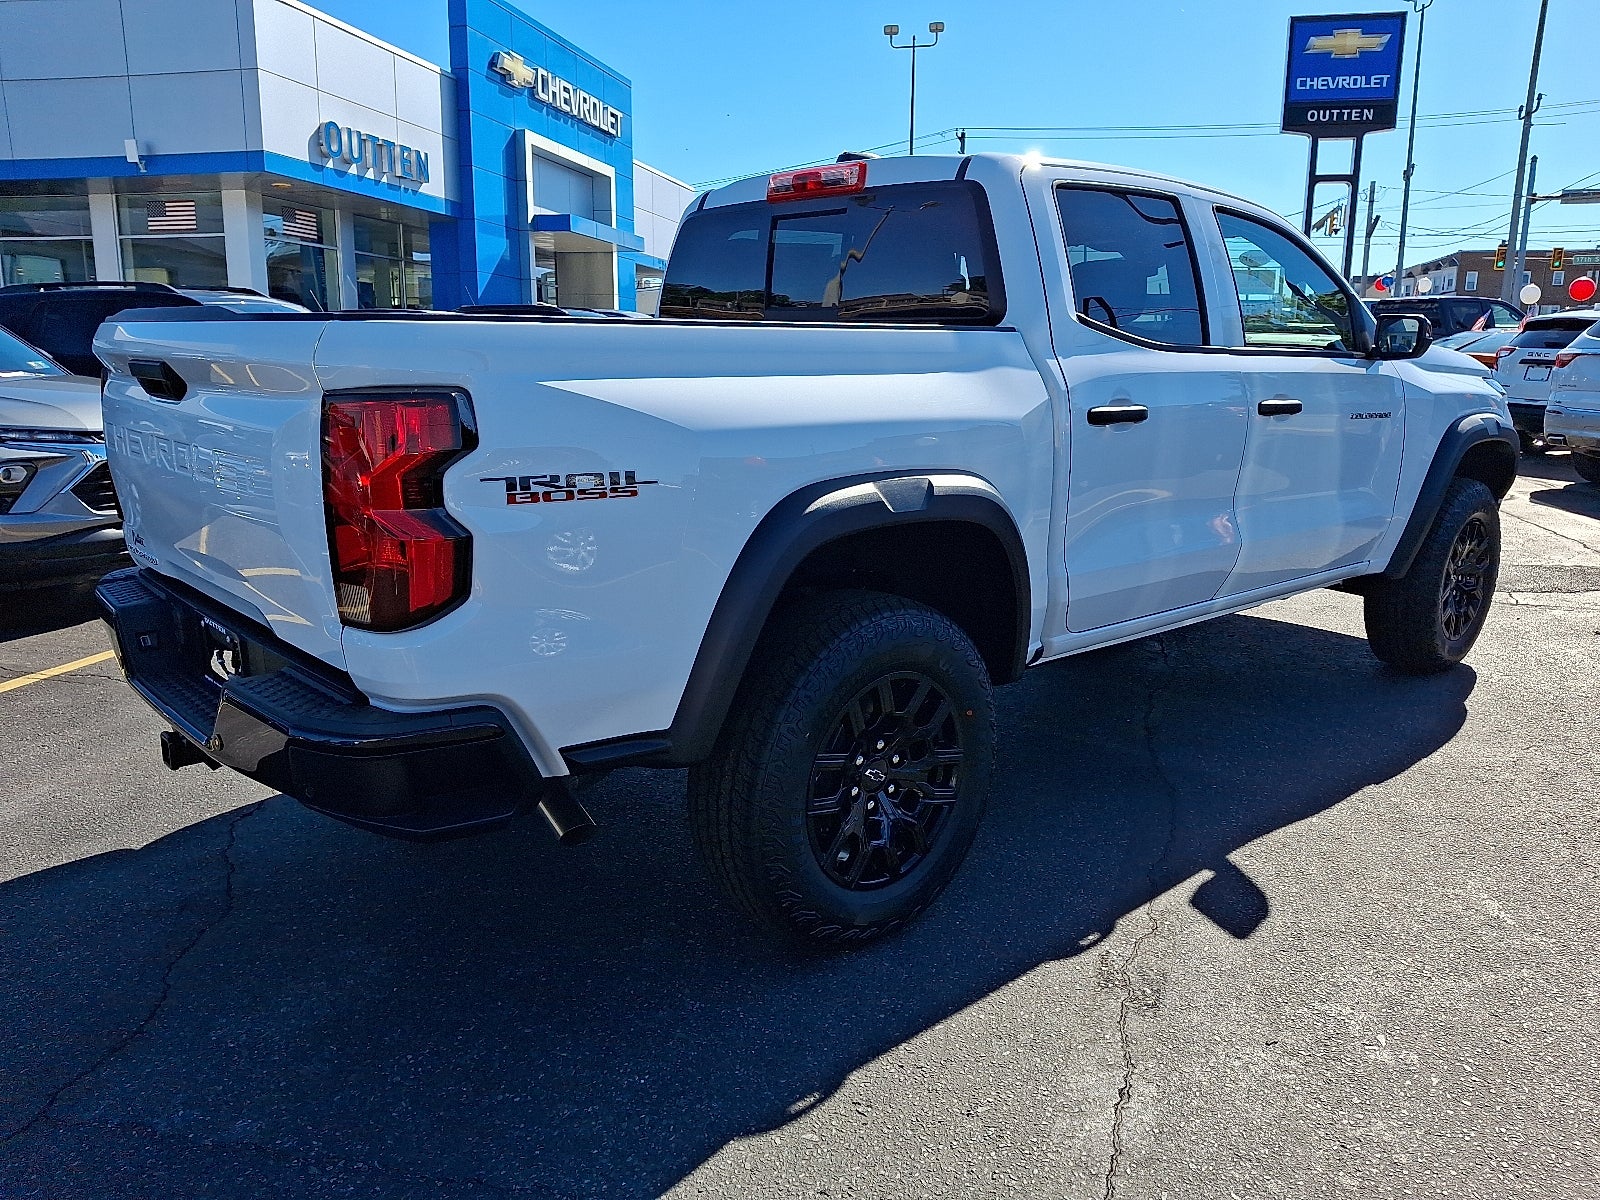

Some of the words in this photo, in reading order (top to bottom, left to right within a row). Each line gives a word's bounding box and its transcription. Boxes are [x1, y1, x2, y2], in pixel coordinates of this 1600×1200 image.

[1296, 74, 1391, 90] CHEVROLET
[536, 67, 623, 138] CHEVROLET
[1306, 108, 1374, 122] OUTTEN
[320, 120, 430, 184] OUTTEN
[479, 470, 659, 493] TRAIL
[506, 485, 639, 506] BOSS
